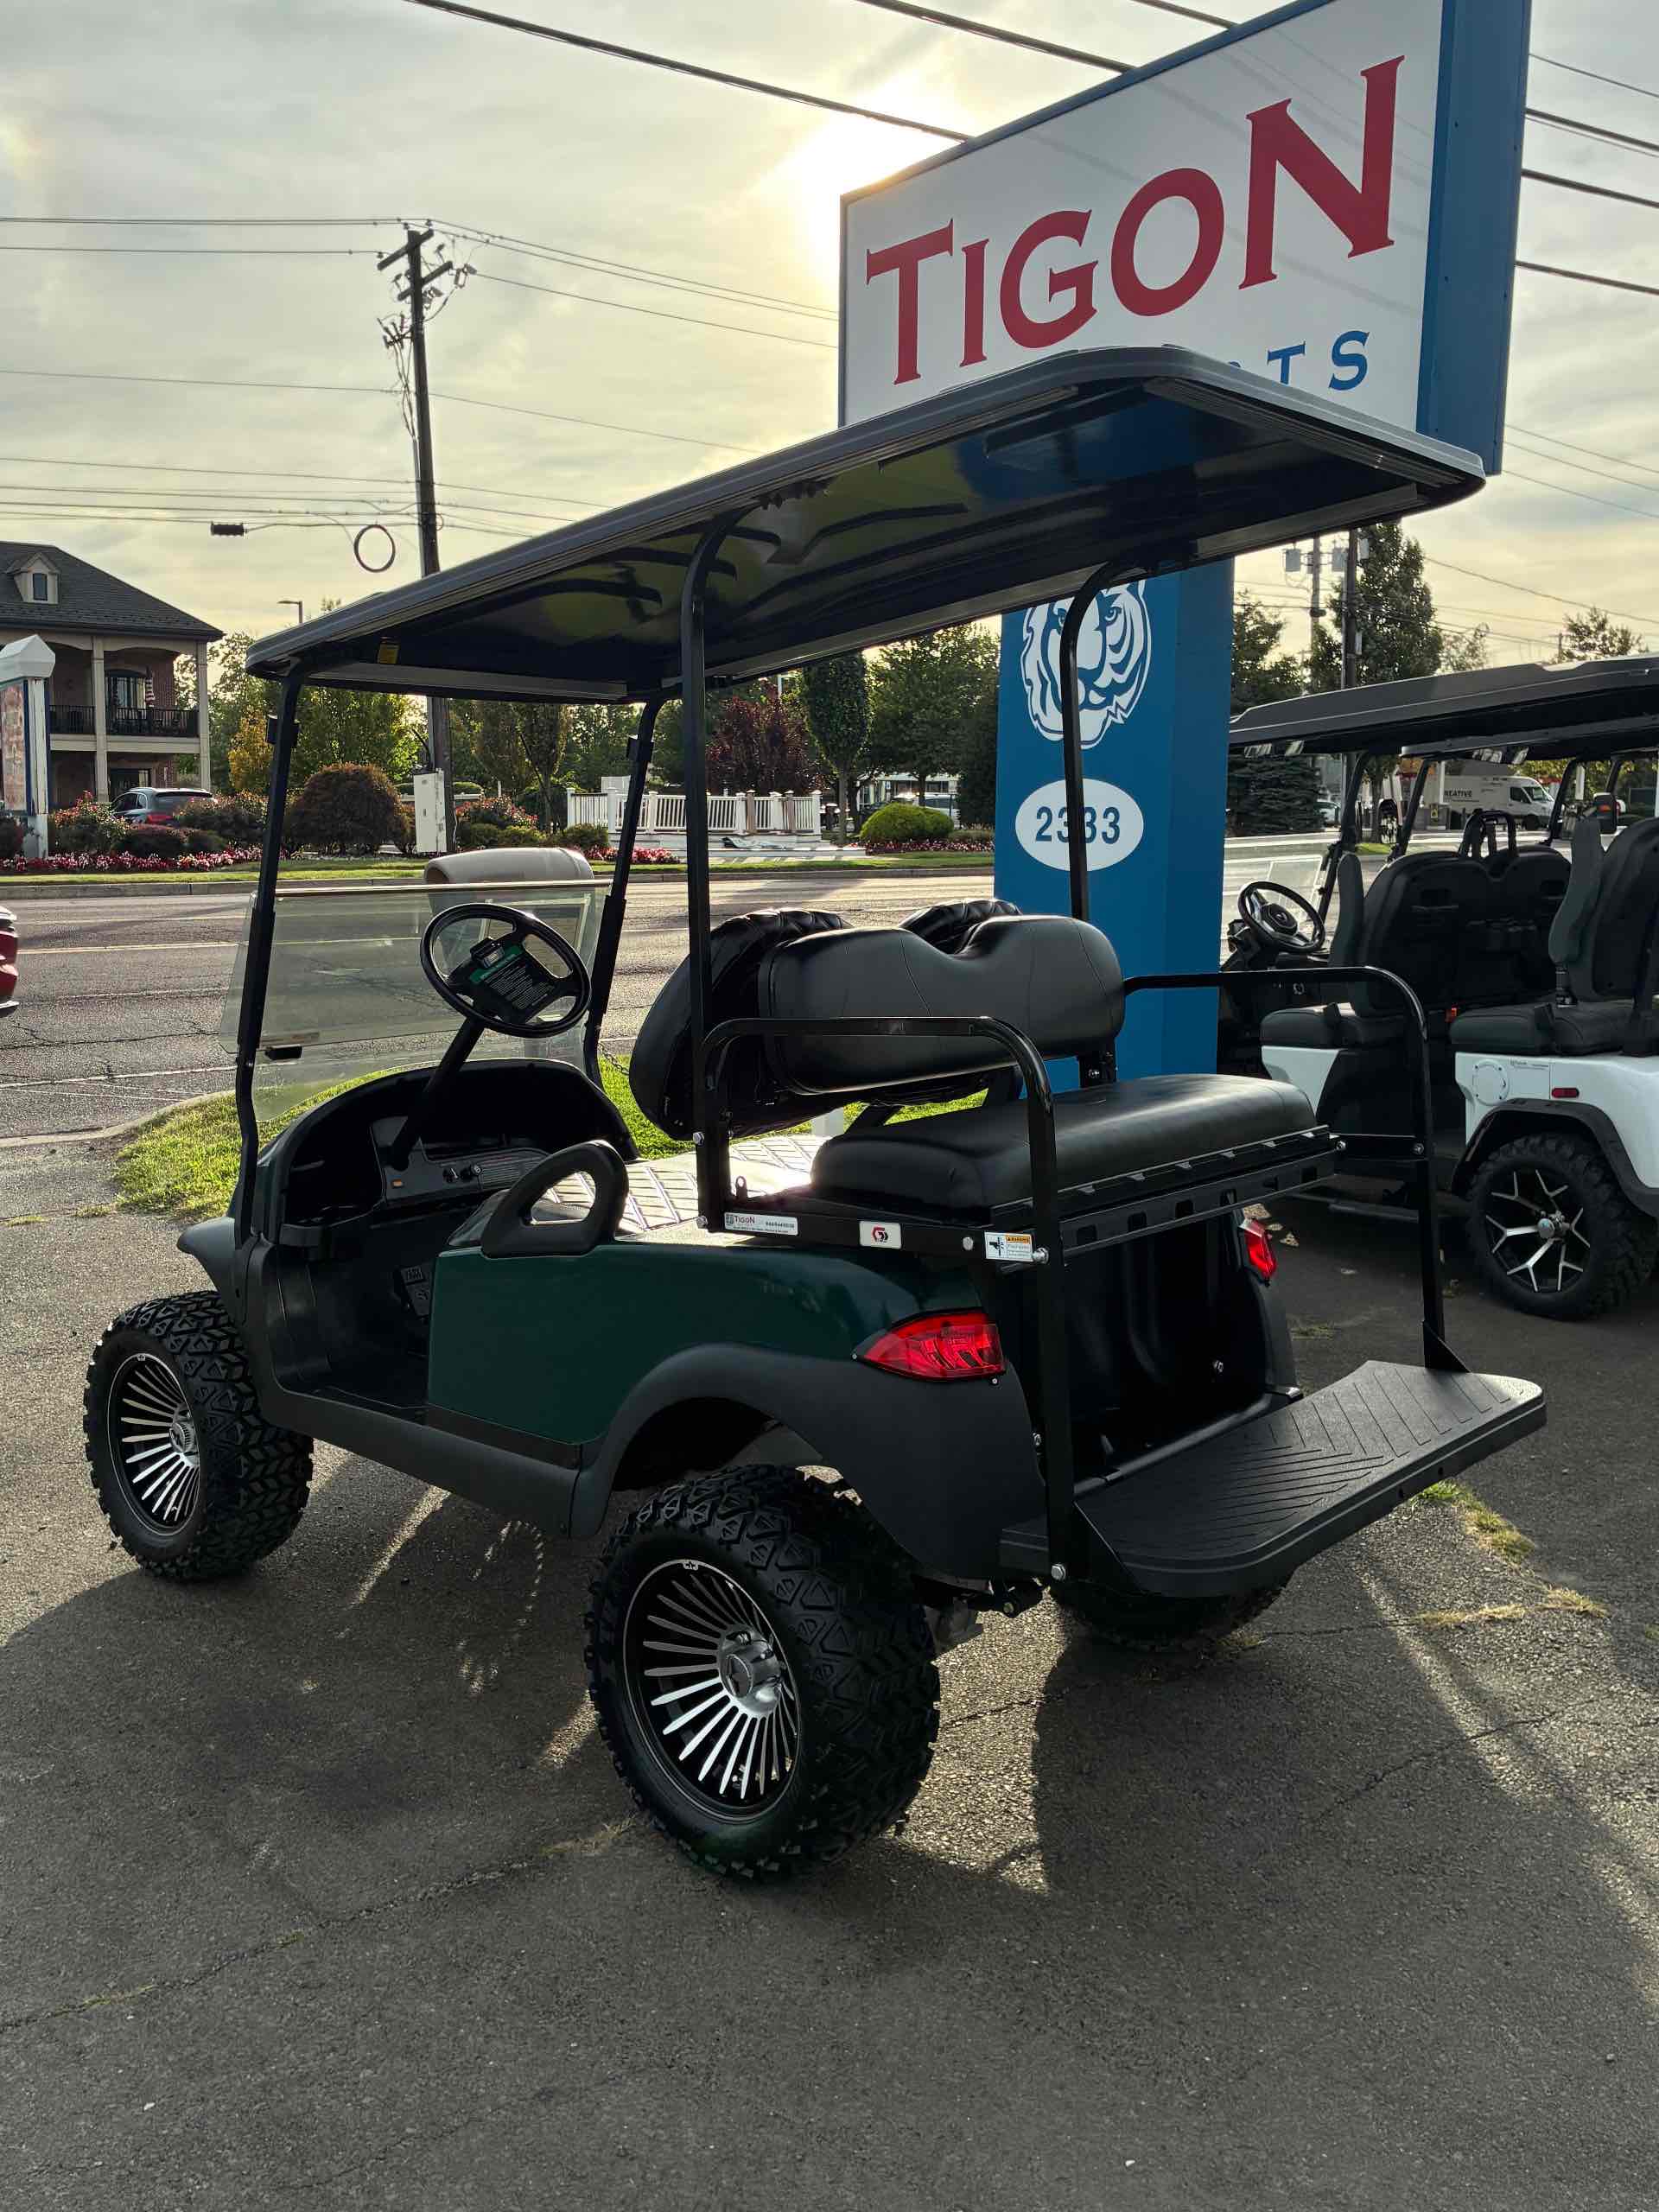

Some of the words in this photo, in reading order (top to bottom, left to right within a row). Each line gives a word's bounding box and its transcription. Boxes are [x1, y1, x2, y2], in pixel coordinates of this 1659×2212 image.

[866, 55, 1406, 385] TIGON
[1229, 330, 1370, 391] TS
[1035, 806, 1121, 844] 2333
